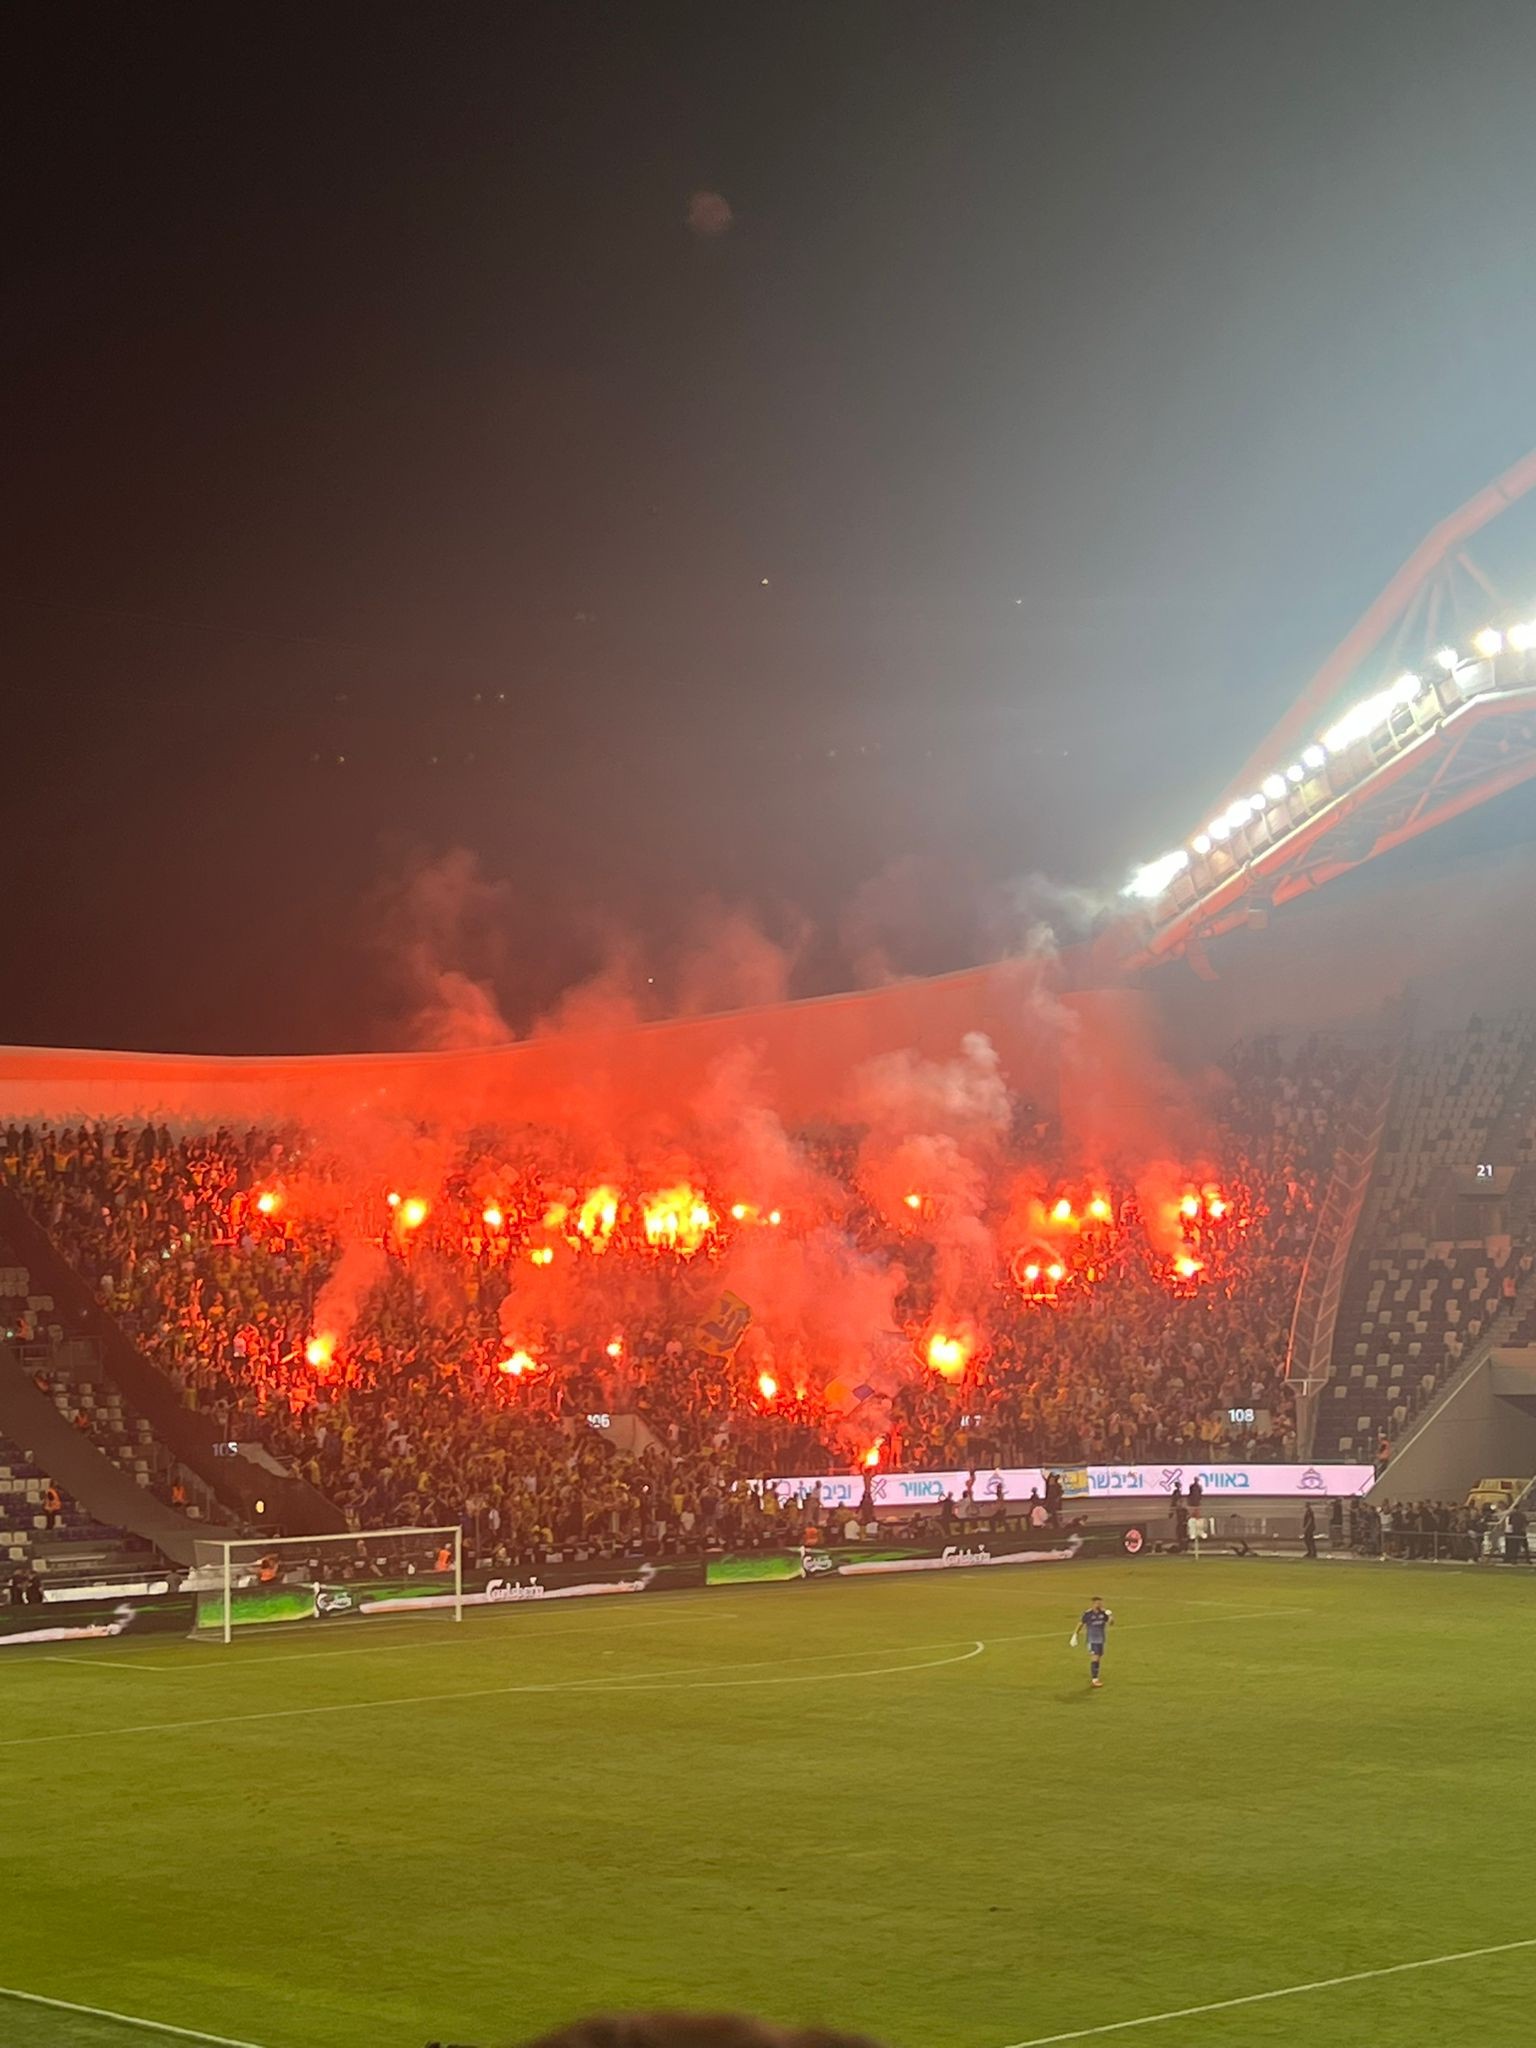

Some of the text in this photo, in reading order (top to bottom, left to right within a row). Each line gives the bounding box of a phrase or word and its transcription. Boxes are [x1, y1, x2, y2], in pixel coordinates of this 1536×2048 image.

[1476, 1164, 1492, 1177] 21
[1228, 1408, 1255, 1422] 108
[211, 1441, 238, 1456] 105
[1198, 1472, 1250, 1488] באוויר
